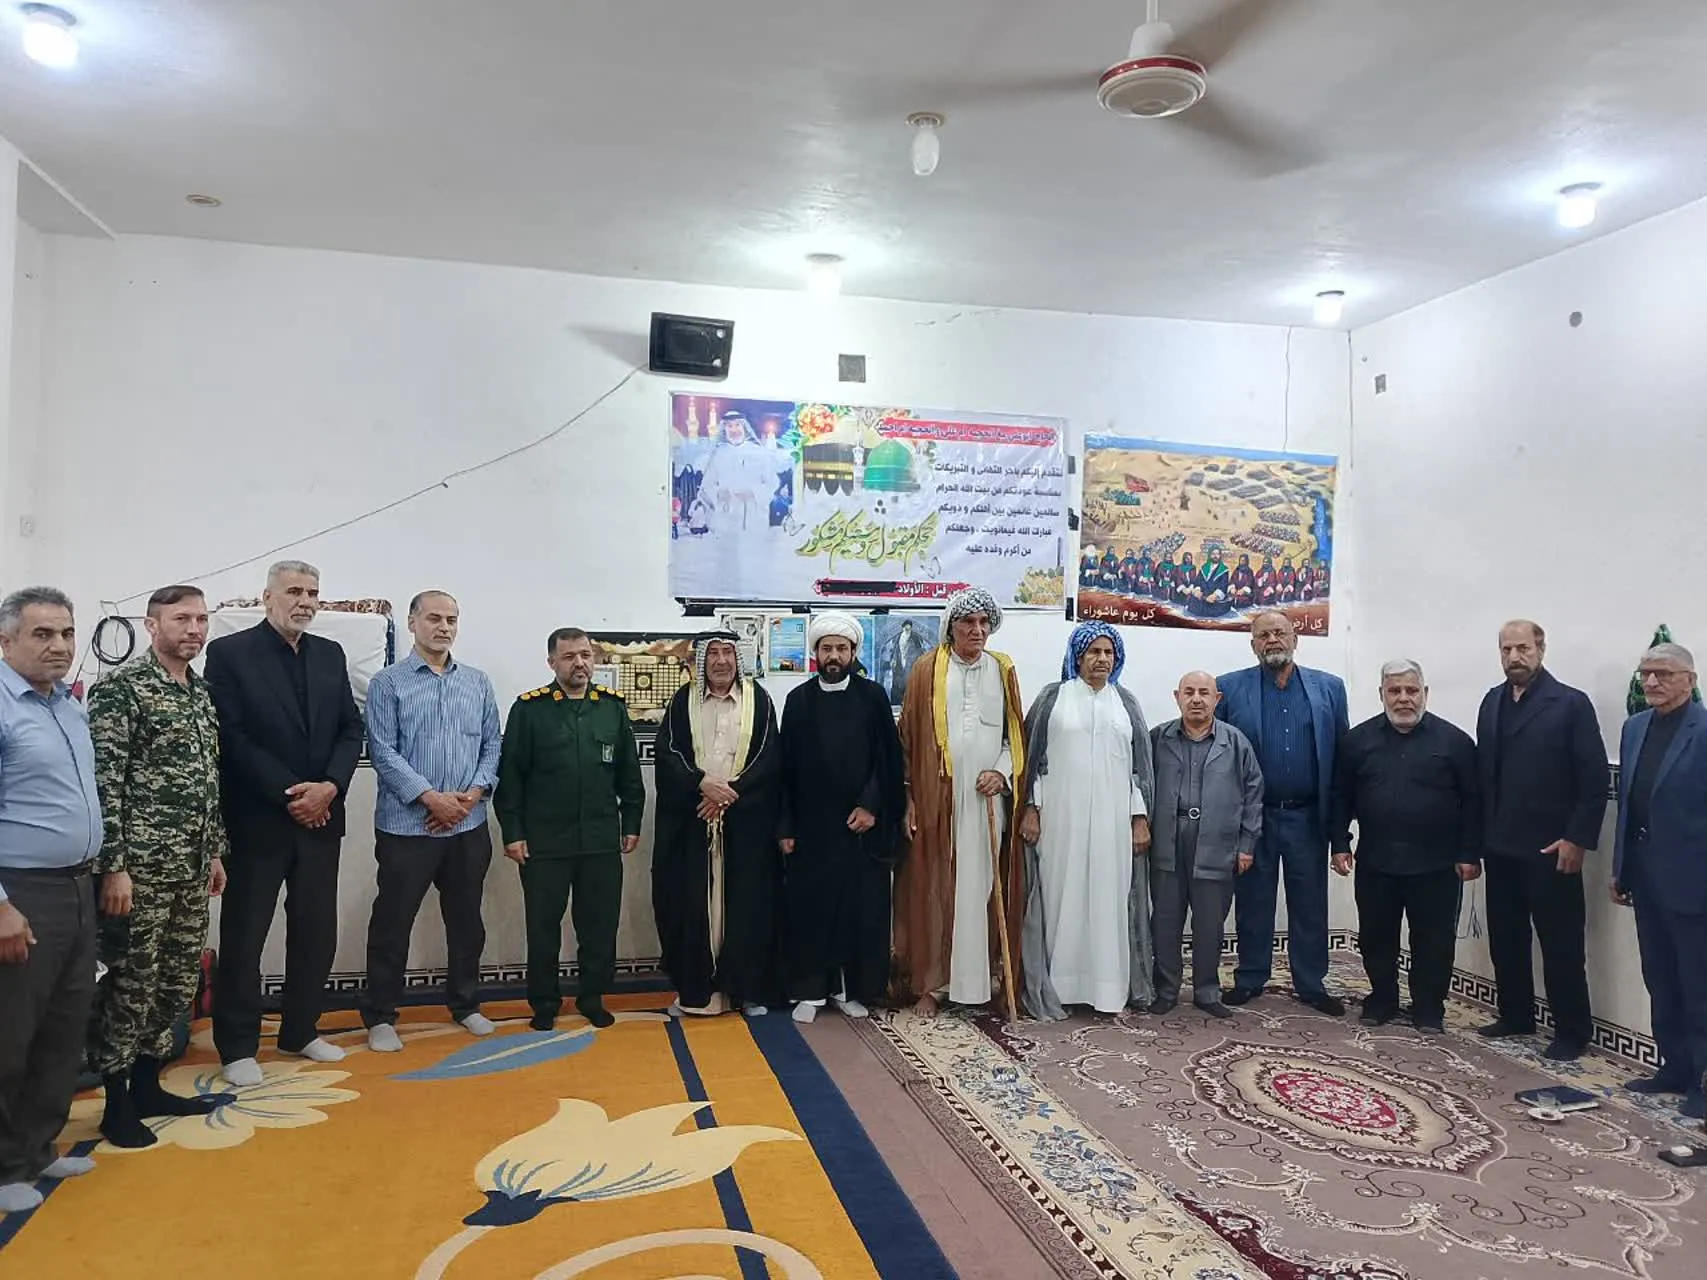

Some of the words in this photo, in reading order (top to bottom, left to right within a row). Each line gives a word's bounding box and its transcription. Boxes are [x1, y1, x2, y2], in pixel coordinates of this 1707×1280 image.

[936, 483, 959, 494] الحرام
[960, 484, 973, 493] الله
[975, 484, 990, 494] بيت
[991, 486, 1002, 496] من
[992, 506, 1005, 516] بين
[1007, 506, 1032, 517] غانمين
[1033, 507, 1060, 517] سالمين
[1017, 526, 1030, 536] الله
[1021, 547, 1031, 557] من
[1083, 604, 1120, 619] عاشوراء
[1122, 609, 1139, 623] يوم
[1142, 607, 1156, 620] كل
[1310, 618, 1323, 630] كل
